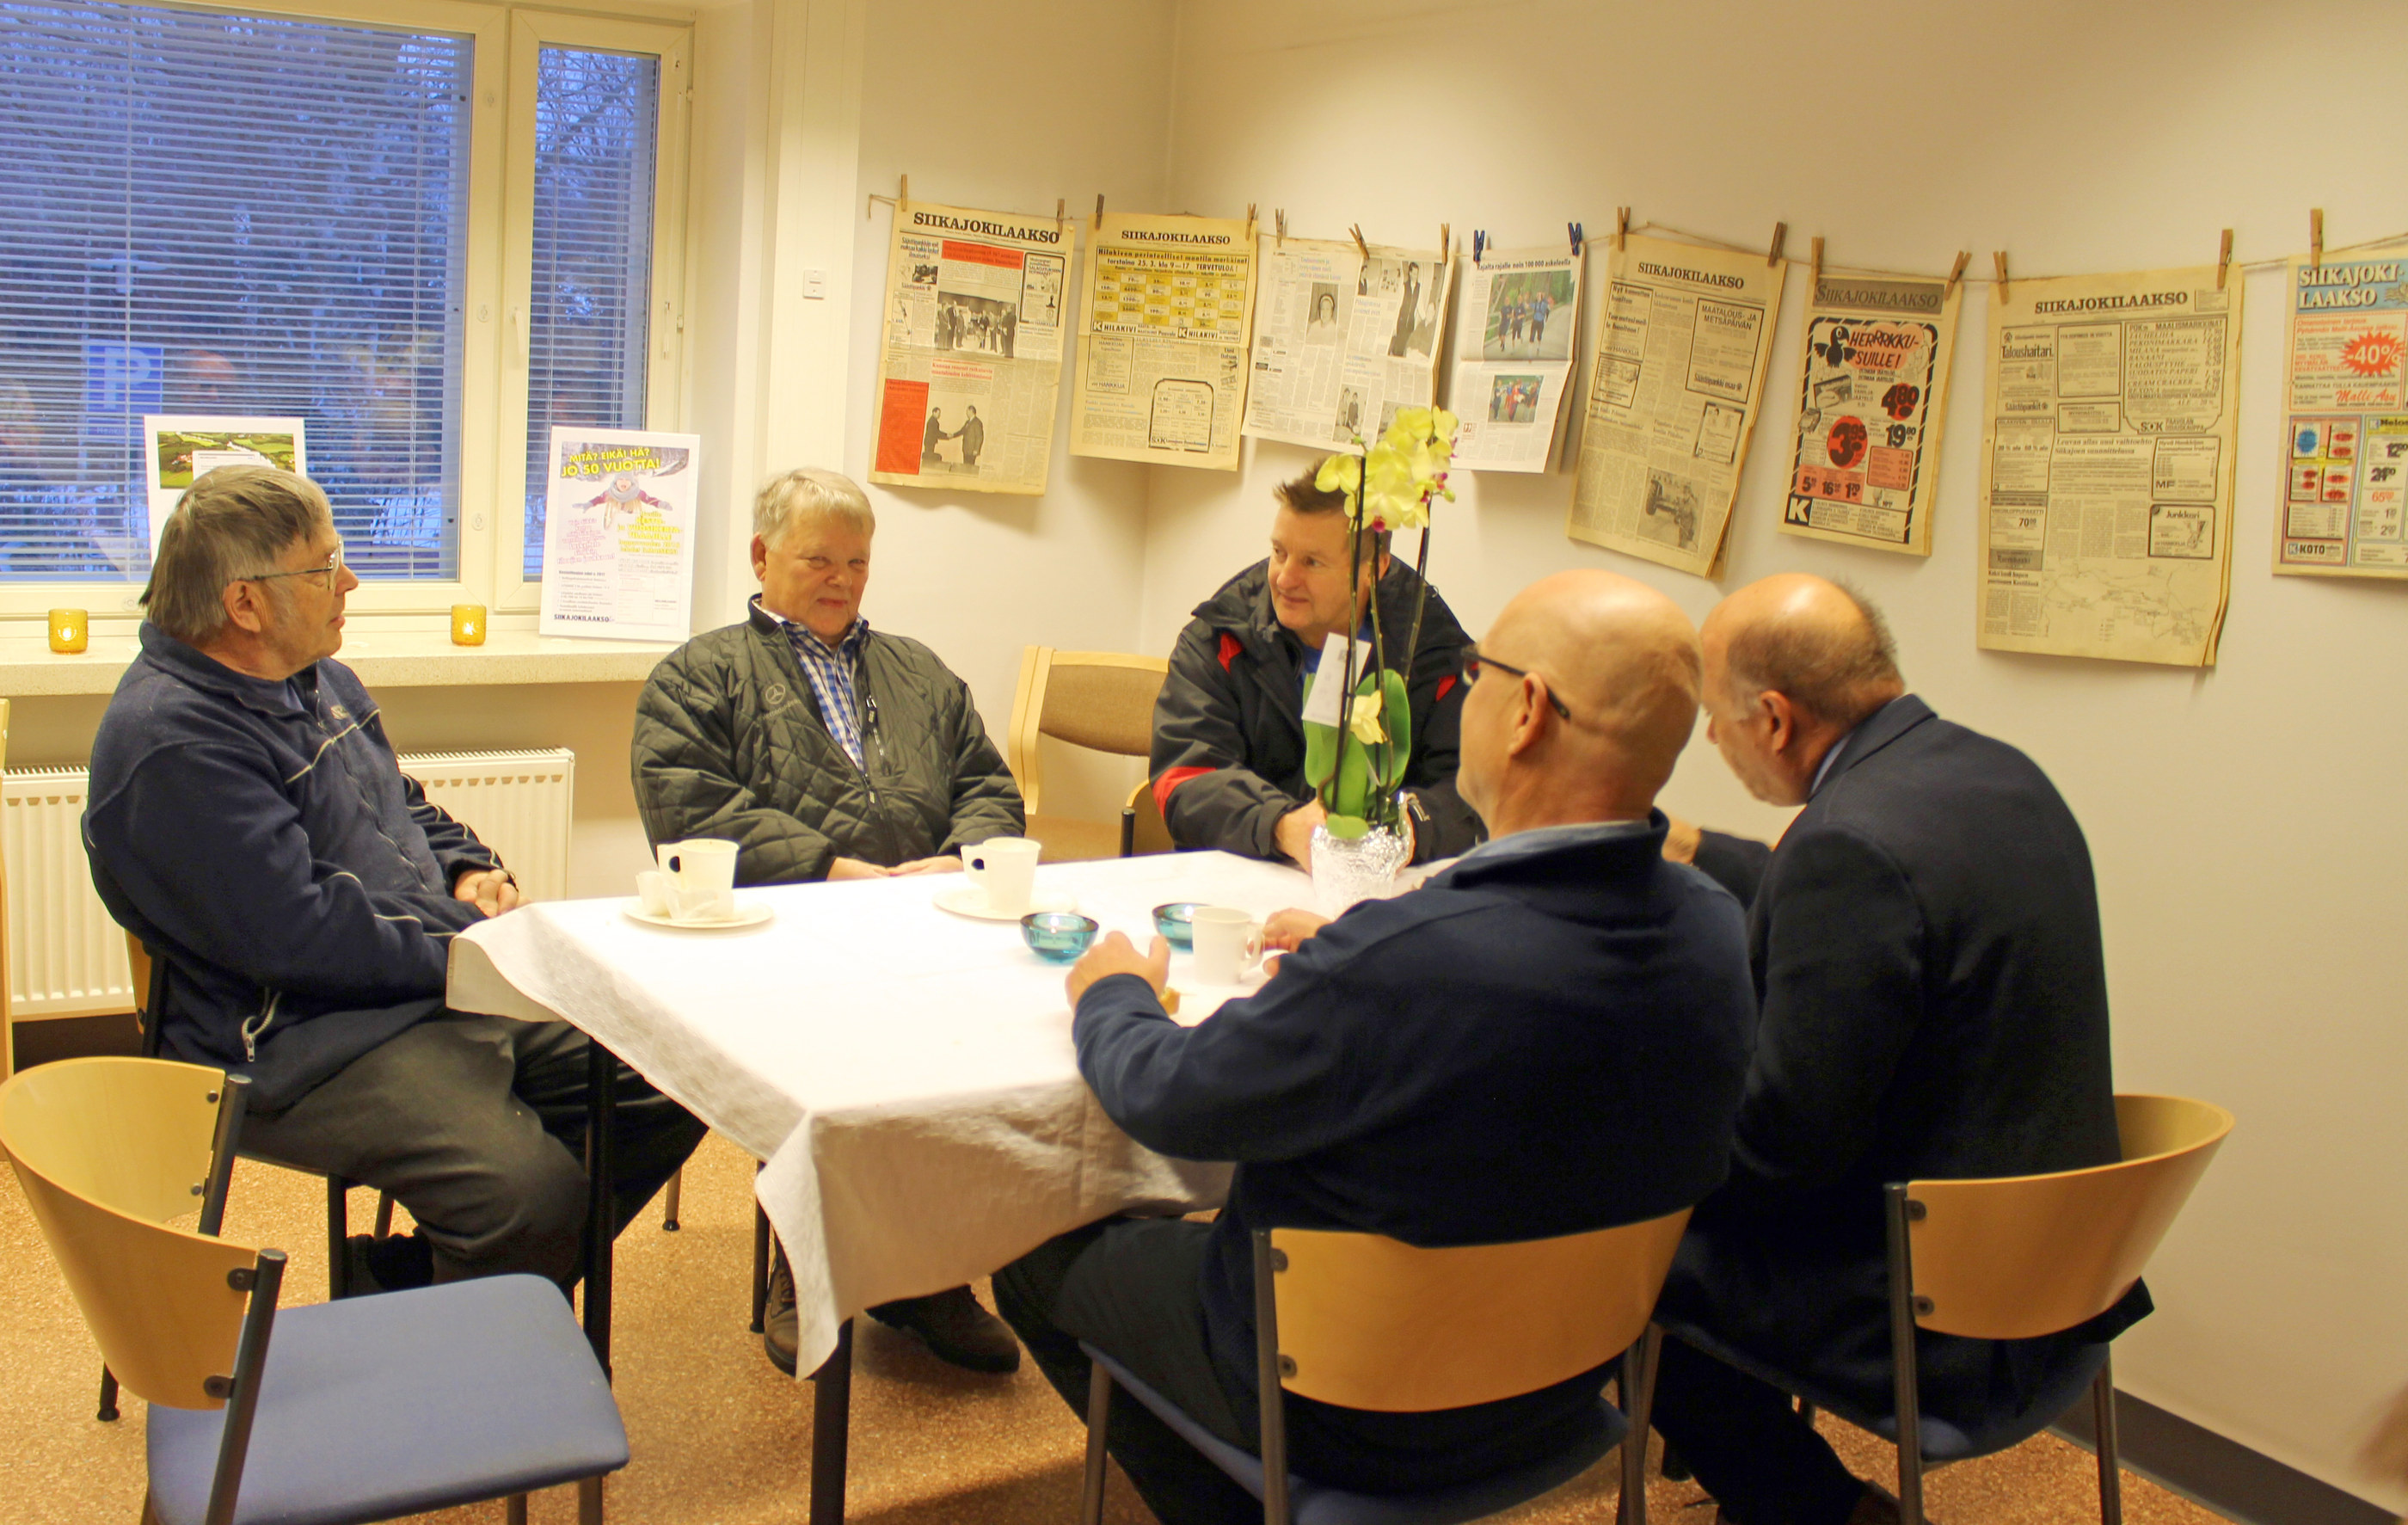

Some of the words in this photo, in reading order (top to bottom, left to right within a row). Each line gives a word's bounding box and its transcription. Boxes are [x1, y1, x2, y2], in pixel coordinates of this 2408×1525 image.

[913, 212, 1060, 244] SIIKAJOKILAAKSO
[1121, 231, 1231, 245] SIIKAJOKILAAKSO
[1637, 262, 1744, 290] SIIKAJOKILAAKSO
[1815, 283, 1939, 308] SIIKAJOKILAAKSO
[2035, 292, 2188, 314] SIIKAJOKILAAKSO
[2298, 288, 2378, 311] LAAKSO
[1702, 305, 1745, 319] MAATALOUS-
[1747, 313, 1756, 322] JA
[1855, 351, 1902, 369] SUILLE!
[2347, 345, 2400, 366] -40%
[104, 347, 150, 409] P
[2116, 437, 2153, 446] vaihtoehto
[569, 451, 598, 463] MITÄ?
[630, 447, 650, 458] HÄ?
[561, 465, 579, 477] JO
[583, 463, 600, 476] 50
[603, 458, 660, 473] VUOTTA!
[2155, 479, 2176, 489] MF
[1787, 496, 1810, 523] K
[2166, 509, 2200, 519] Junkkari
[2300, 544, 2325, 555] KOTO
[554, 614, 610, 623] SIIKAJOKILAAKSO
